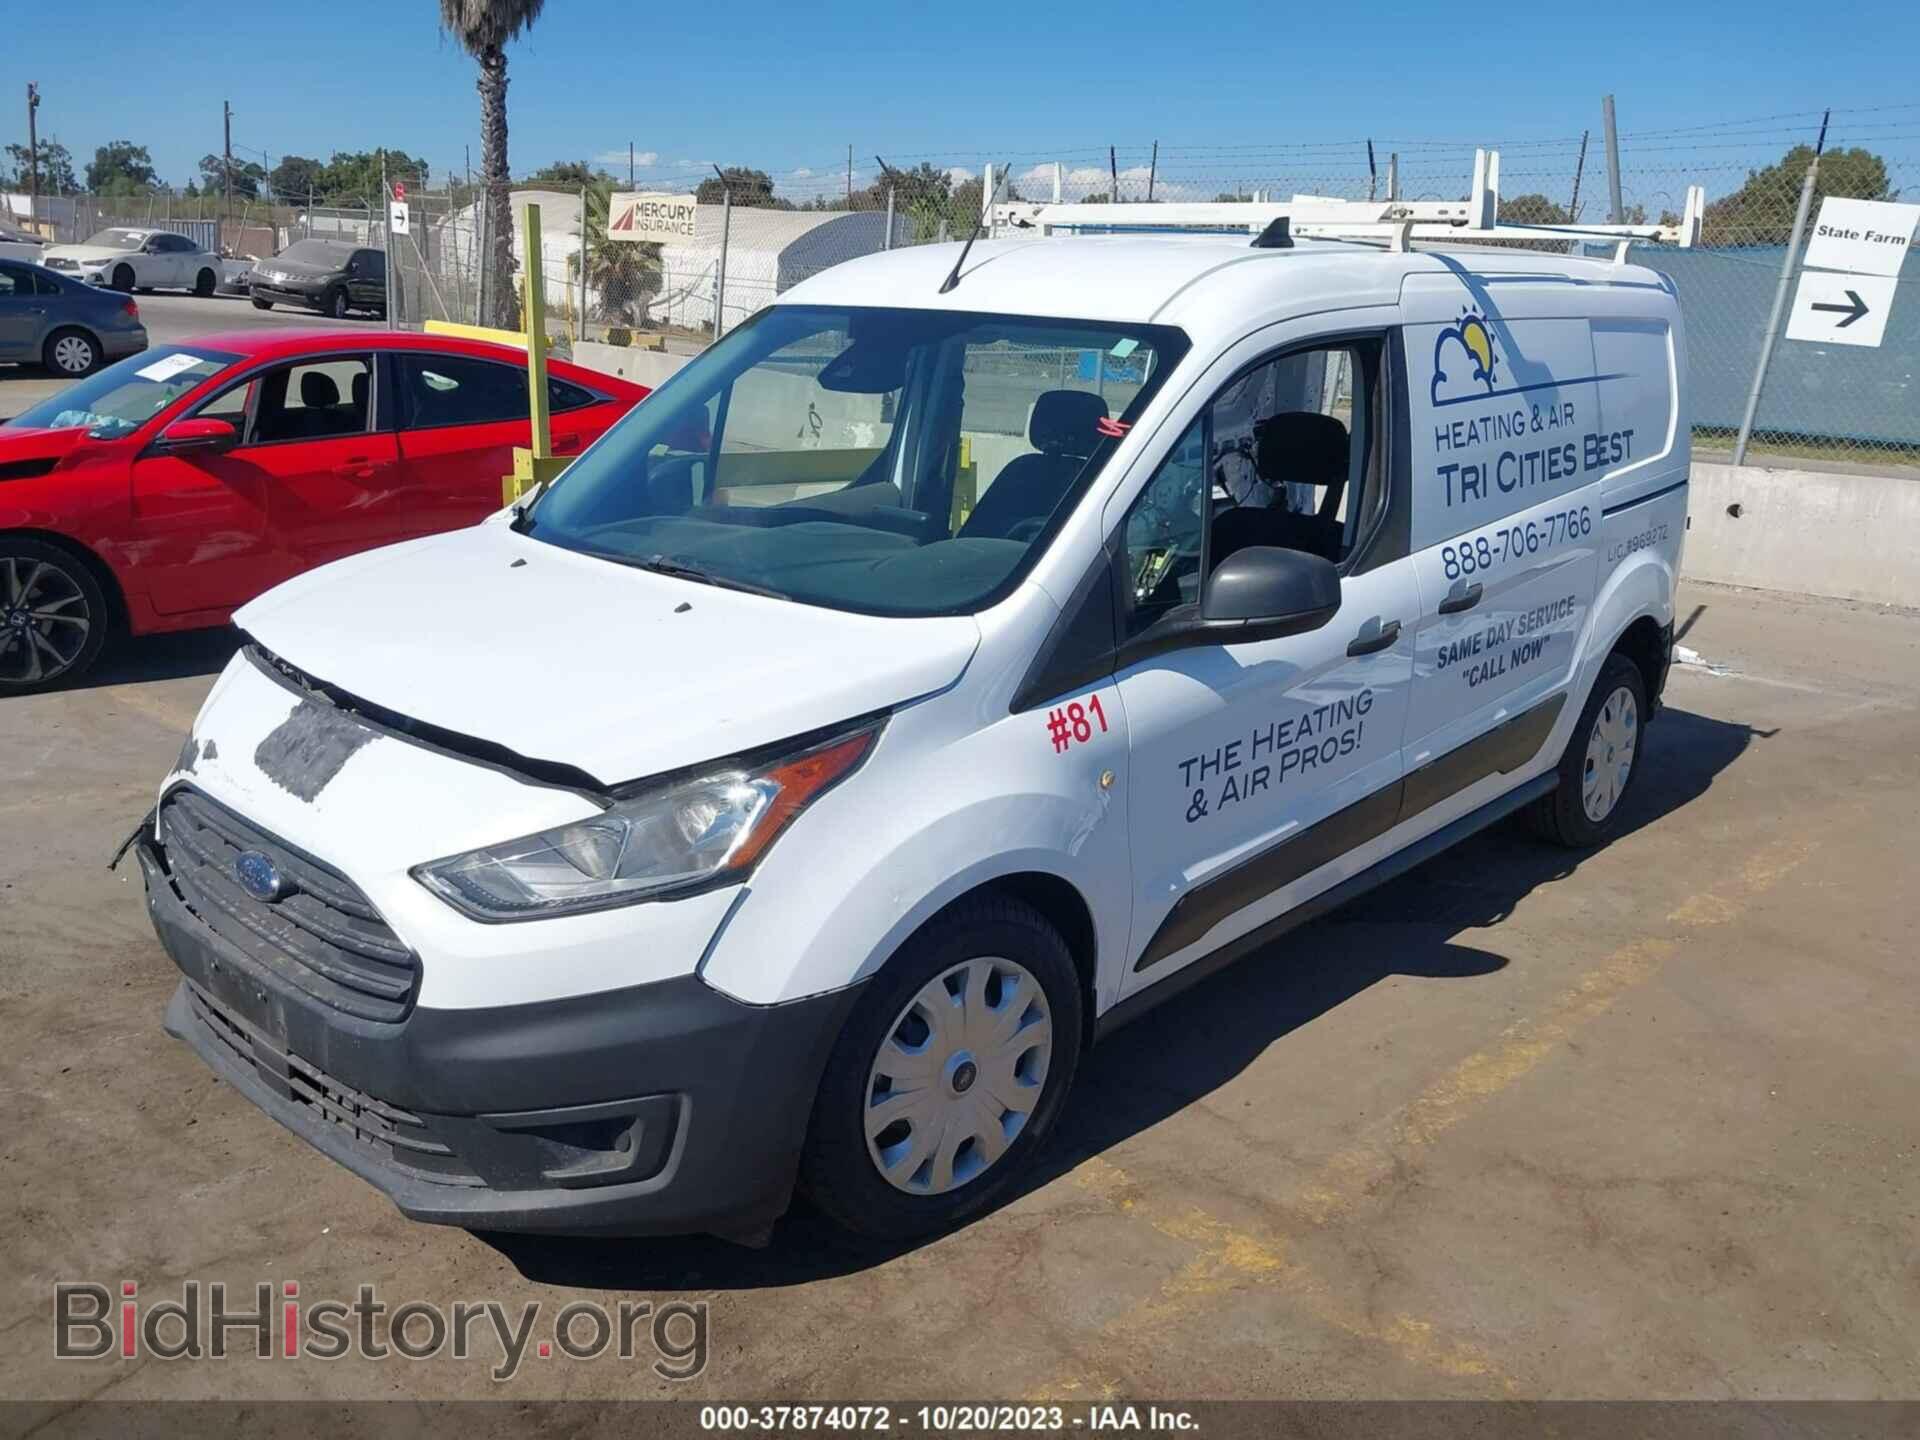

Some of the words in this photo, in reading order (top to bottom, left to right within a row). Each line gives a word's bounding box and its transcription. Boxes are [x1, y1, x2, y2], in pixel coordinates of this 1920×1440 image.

[636, 202, 695, 220] MERCURY
[1817, 225, 1859, 240] State
[1864, 230, 1906, 245] Farm
[1435, 410, 1525, 452] HEATING
[1530, 404, 1543, 433] &
[1548, 402, 1575, 430] AIR
[1437, 463, 1487, 507] TRI
[1496, 443, 1577, 493] CITIES
[1583, 429, 1634, 472] BEST
[1442, 506, 1591, 580] 888-706-7766
[1437, 632, 1482, 669] SAME
[1486, 619, 1515, 650] DAY
[1517, 595, 1575, 636] SERVICE
[1462, 657, 1506, 688] "CALL
[1510, 635, 1550, 670] NOW"
[1047, 694, 1108, 754] #81
[1178, 740, 1243, 788] THE
[1252, 688, 1374, 761] HEATING
[1185, 789, 1209, 824] &
[1217, 764, 1270, 811] AIR
[1279, 720, 1364, 783] PROS!
